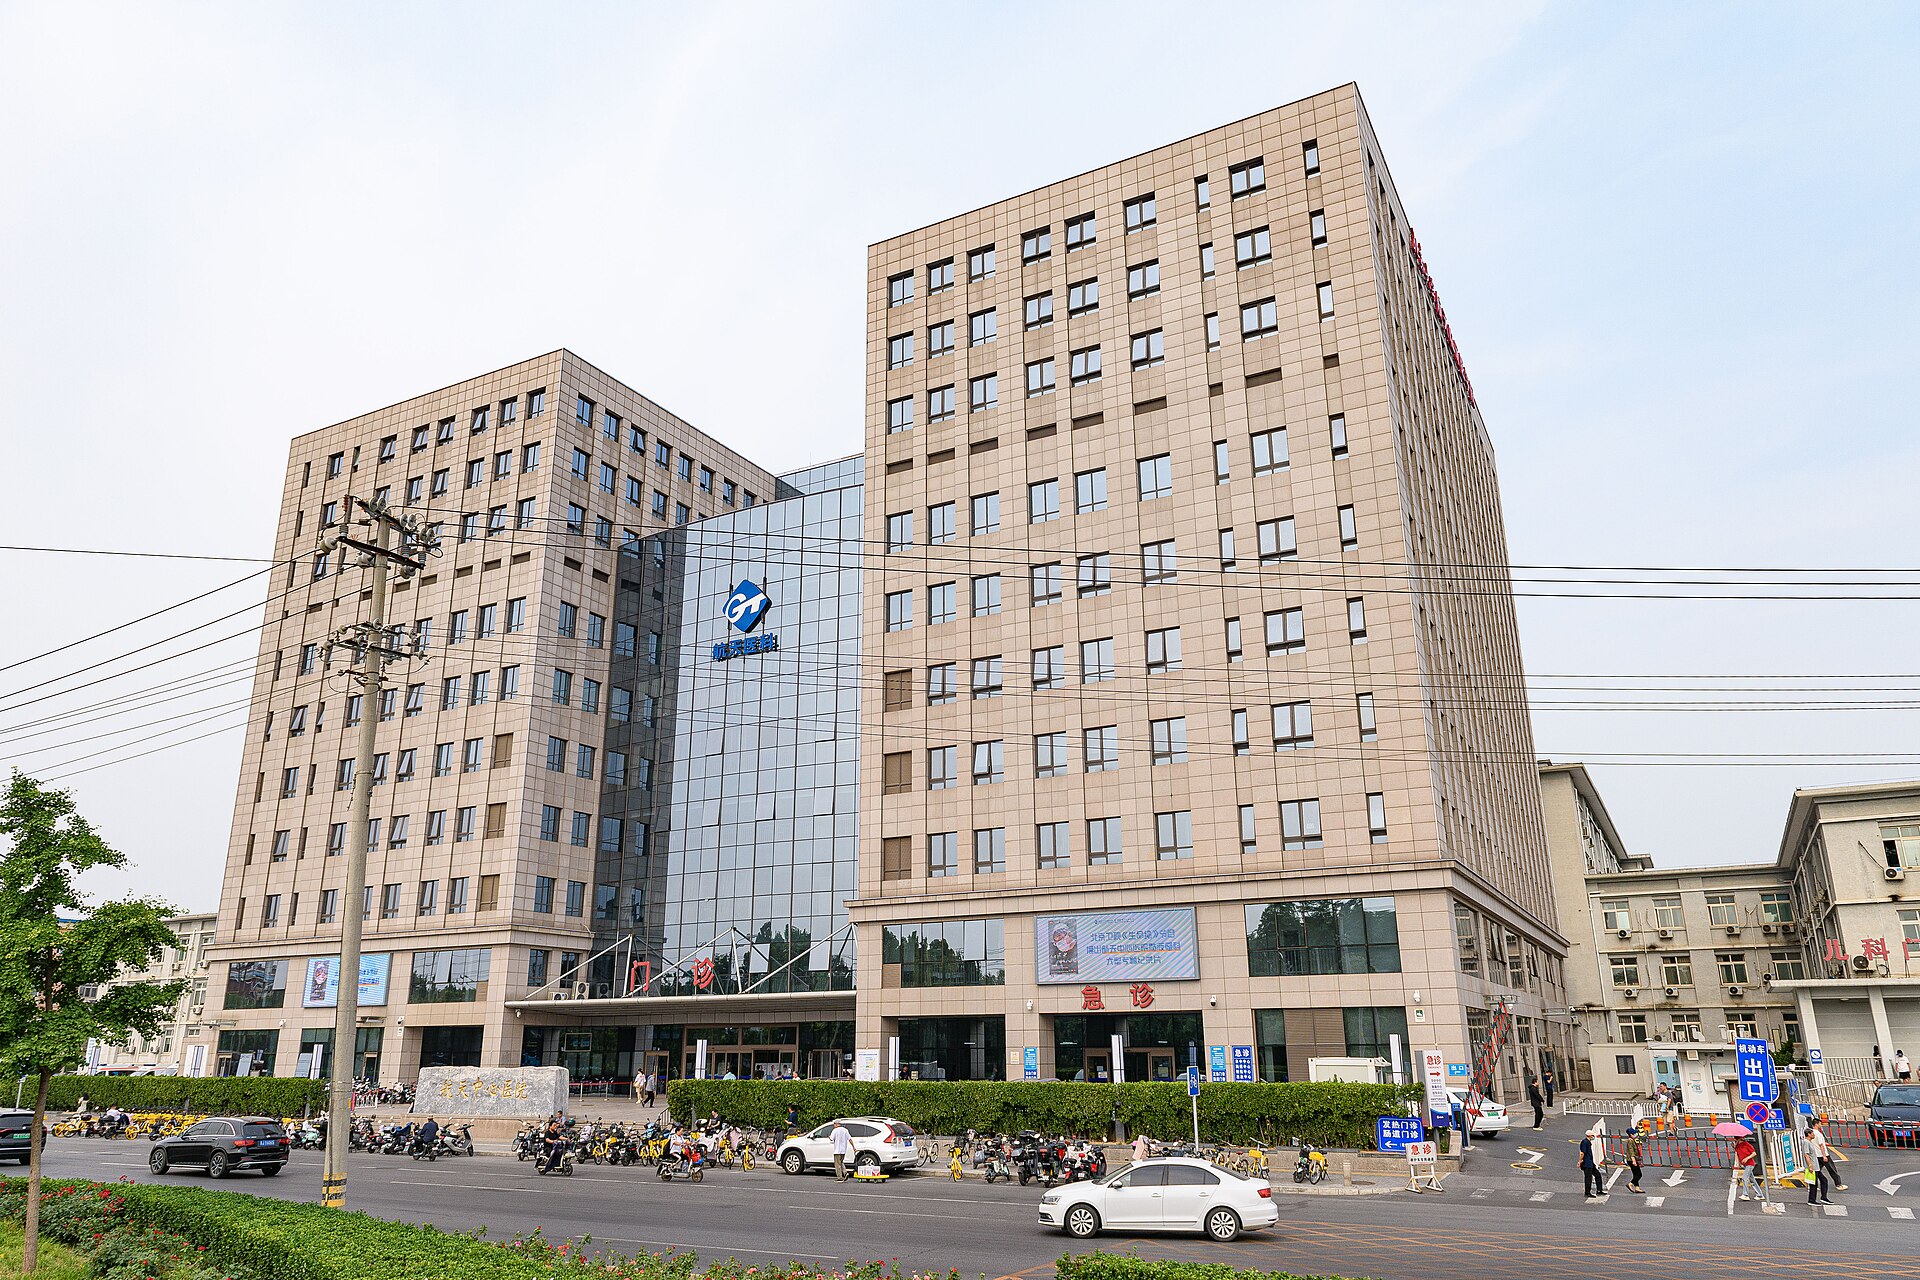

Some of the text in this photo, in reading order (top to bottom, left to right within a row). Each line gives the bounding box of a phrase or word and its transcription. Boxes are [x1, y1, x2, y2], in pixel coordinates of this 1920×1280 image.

[713, 632, 775, 660] 航天医科
[630, 957, 715, 992] 门诊
[1081, 983, 1155, 1010] 急诊
[1234, 1048, 1250, 1057] 急诊
[1738, 1044, 1765, 1054] 机动车
[1426, 1055, 1442, 1066] 急诊
[1744, 1057, 1764, 1098] 出口
[439, 1077, 529, 1101] 航天中心医院
[1382, 1120, 1418, 1130] 发热门诊
[1382, 1129, 1419, 1139] 肠道门诊
[1411, 1143, 1432, 1156] 急诊
